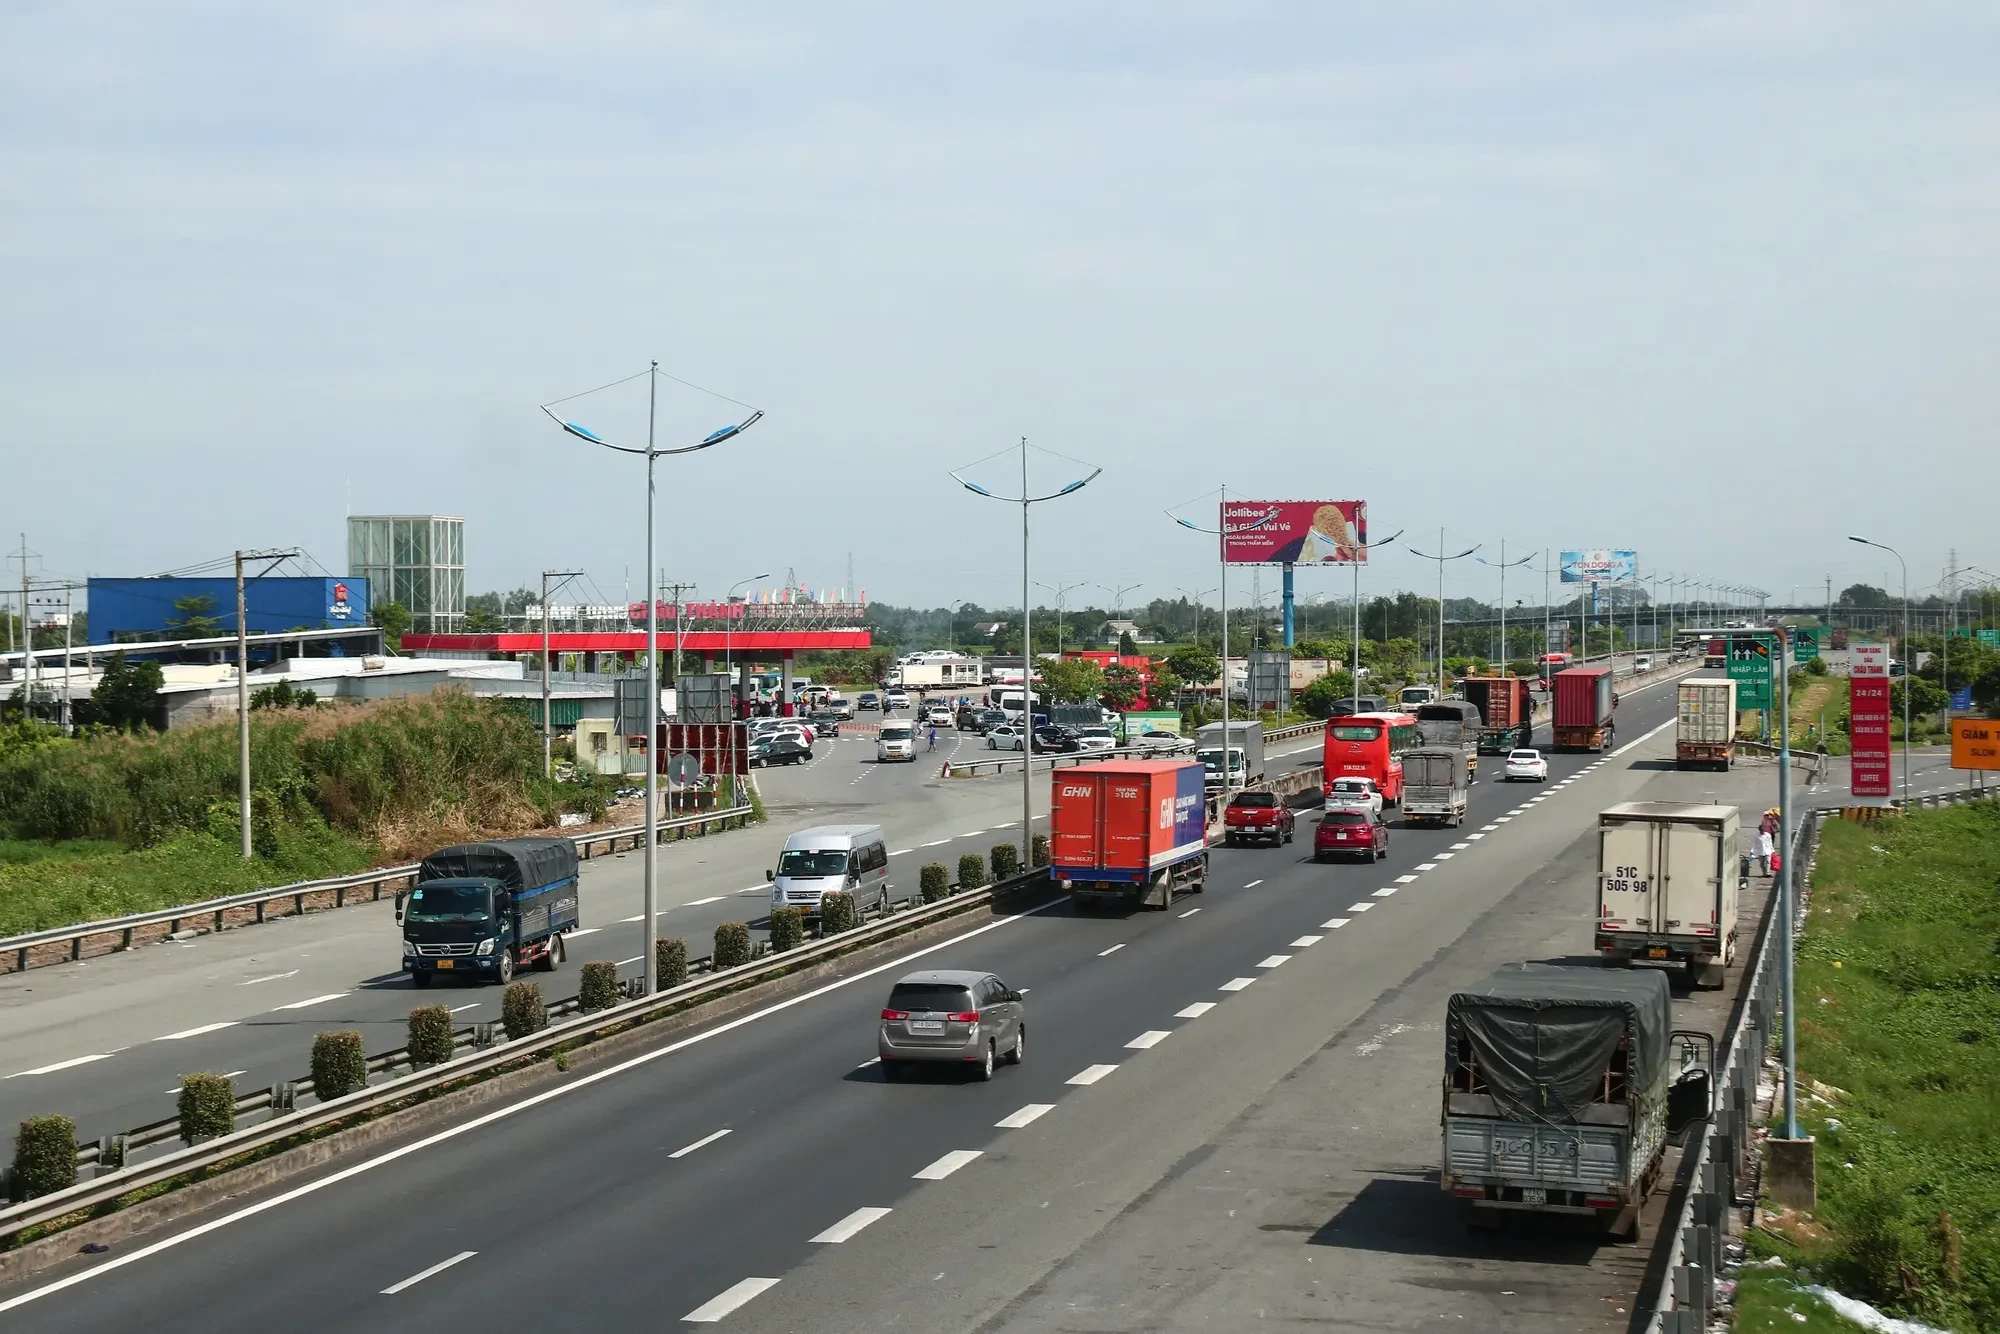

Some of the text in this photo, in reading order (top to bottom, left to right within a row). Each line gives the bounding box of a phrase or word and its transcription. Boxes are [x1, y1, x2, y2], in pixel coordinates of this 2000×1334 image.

[1225, 507, 1265, 517] Jollibee
[1263, 522, 1278, 531] Vui
[1279, 521, 1291, 531] Vẻ
[1970, 748, 1996, 757] SLOW
[1062, 786, 1092, 798] GHN
[1160, 796, 1175, 830] GHN
[1616, 866, 1638, 879] 51C
